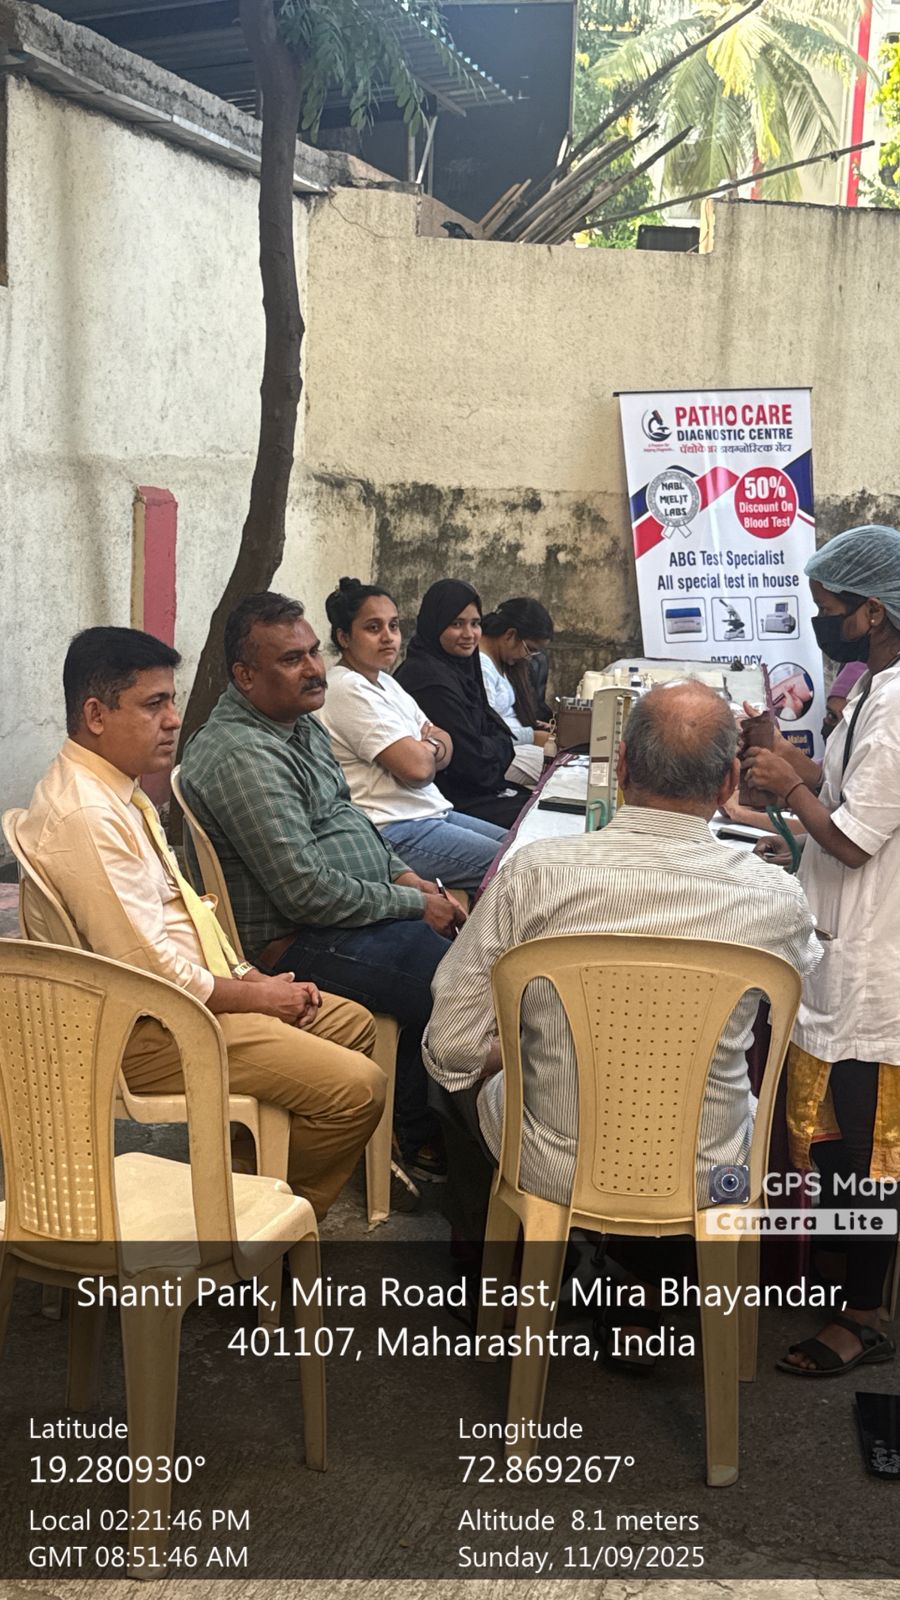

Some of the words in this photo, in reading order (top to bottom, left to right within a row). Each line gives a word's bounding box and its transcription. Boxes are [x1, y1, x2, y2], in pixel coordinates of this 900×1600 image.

[675, 404, 737, 427] PATHO
[741, 404, 792, 425] CARE
[677, 429, 745, 441] DIAGNOSTIC
[749, 428, 793, 440] CENTRE
[661, 482, 685, 491] NABL
[744, 475, 787, 499] 50%
[664, 508, 687, 516] LABS
[739, 501, 778, 513] Discount
[781, 501, 793, 511] On
[743, 517, 769, 528] Blood
[771, 516, 790, 527] Test
[669, 551, 696, 567] ABG
[699, 550, 723, 566] Test
[726, 549, 784, 569] Specialist
[657, 575, 674, 590] All
[678, 573, 720, 592] special
[724, 573, 744, 588] test
[748, 573, 759, 587] in
[763, 572, 799, 588] house
